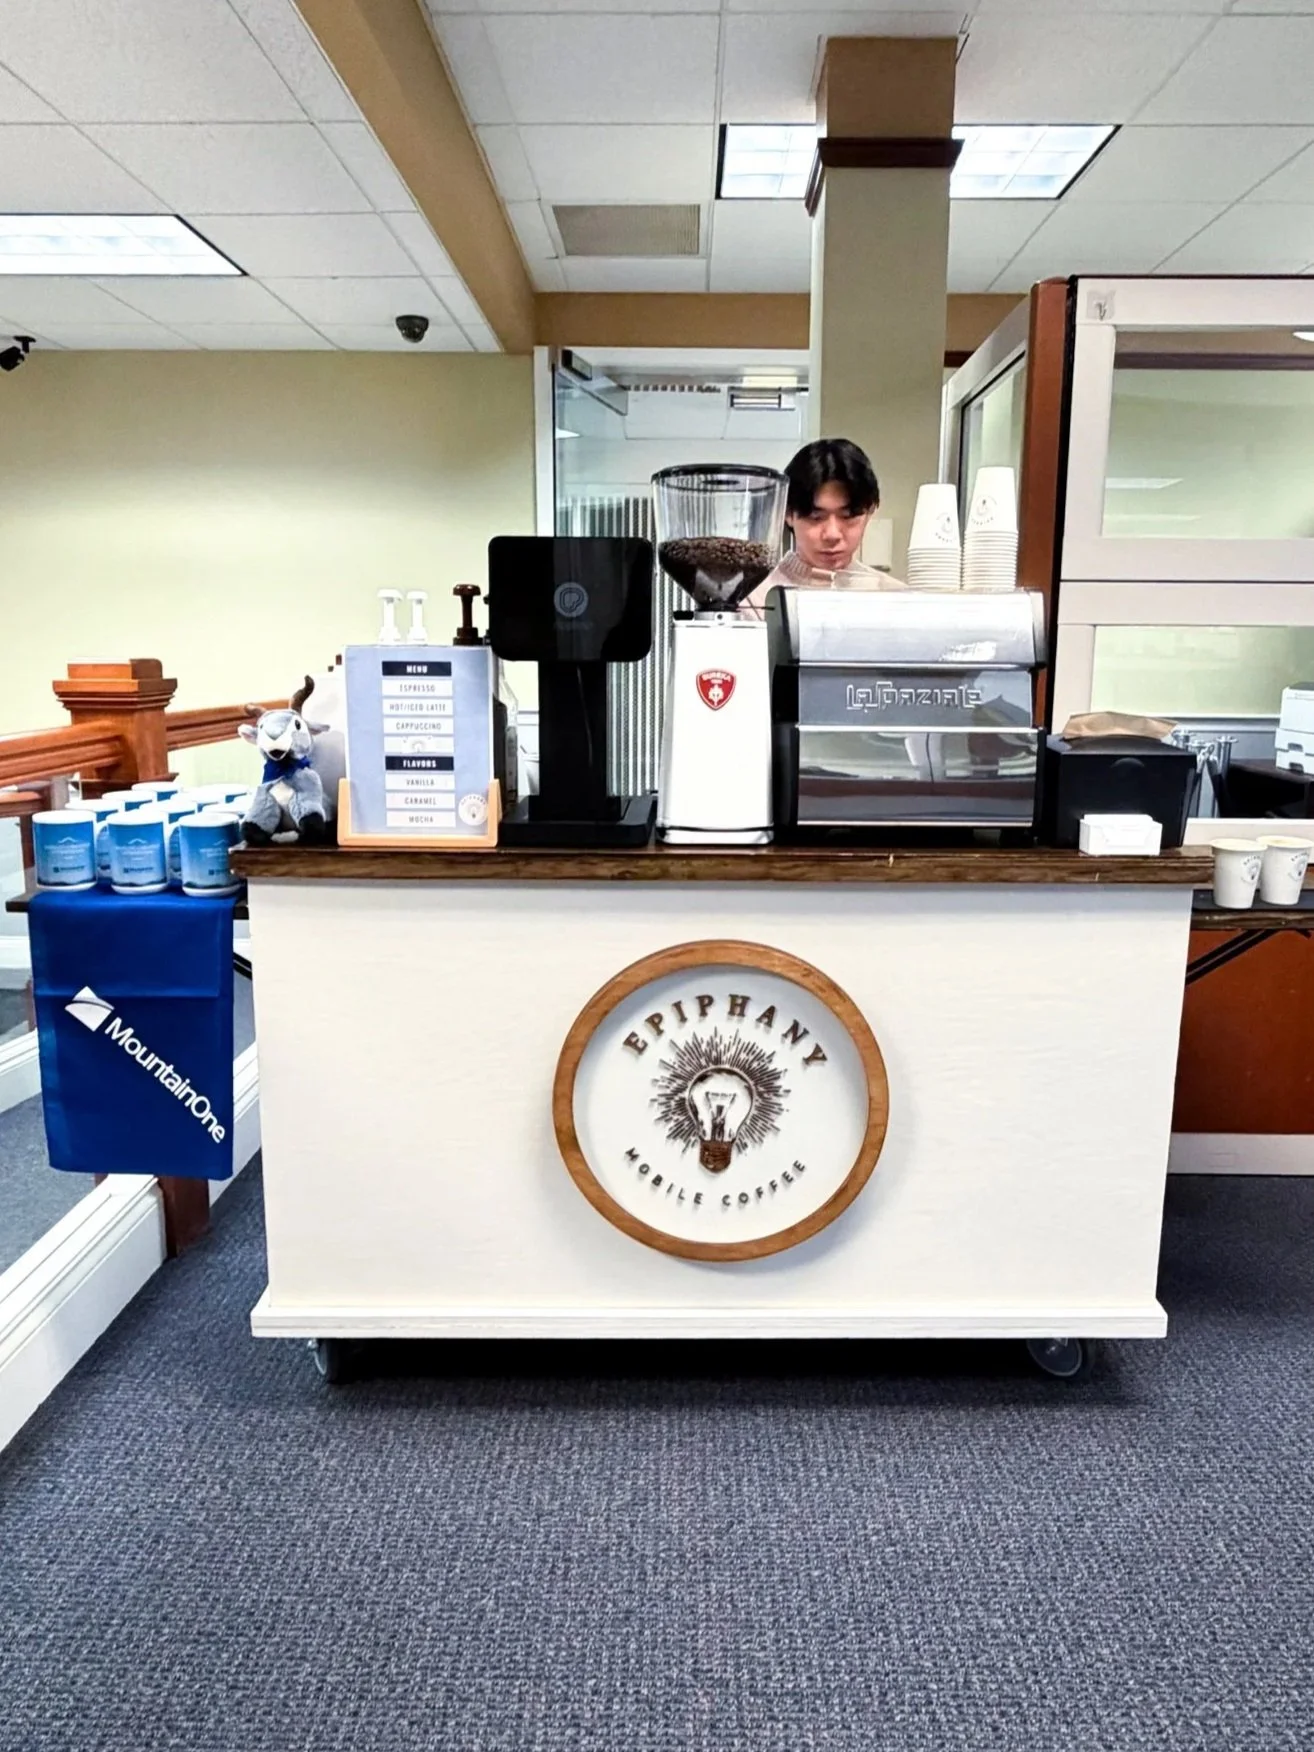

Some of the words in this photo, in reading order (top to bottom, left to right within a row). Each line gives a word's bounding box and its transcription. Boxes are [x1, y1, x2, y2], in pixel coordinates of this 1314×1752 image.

[406, 664, 428, 674] MENU
[399, 683, 436, 693] ESPRESSO
[389, 703, 424, 712] HOT/ICED
[426, 703, 446, 712] LATTE
[395, 721, 442, 731] CAPPUCCINO
[402, 759, 437, 769] FLAVORS
[406, 779, 435, 787] VANILLA
[404, 796, 438, 805] CARAMEL
[408, 815, 434, 824] MOCHA
[623, 994, 828, 1065] EPIPHANY
[104, 1016, 226, 1144] MountainOne
[625, 1147, 703, 1205] MOBILE
[722, 1160, 805, 1207] COFFEE
